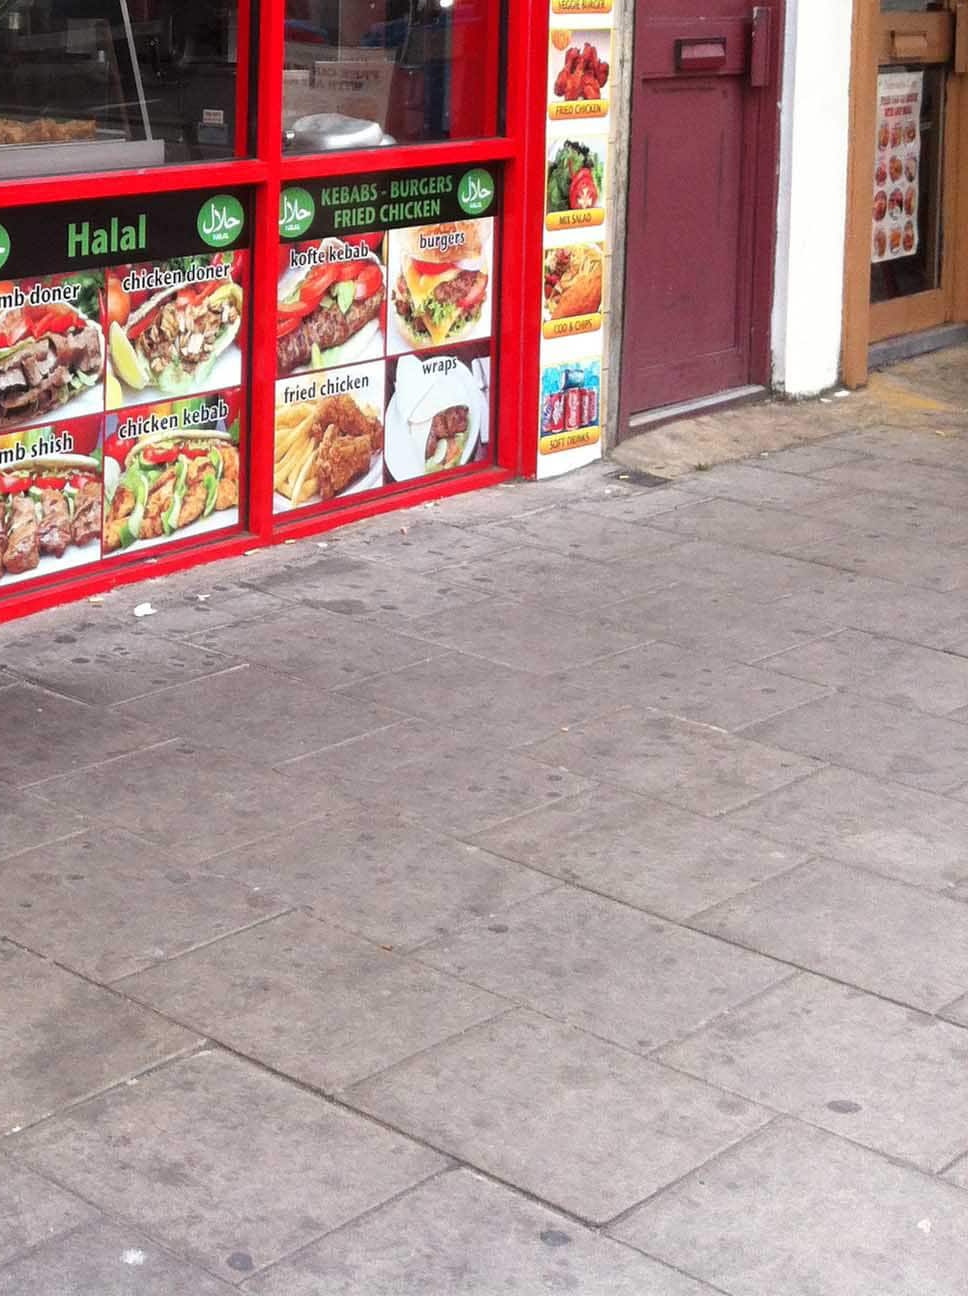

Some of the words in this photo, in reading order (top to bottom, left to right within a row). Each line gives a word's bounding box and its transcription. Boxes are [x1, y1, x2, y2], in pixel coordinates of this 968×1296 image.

[555, 105, 573, 115] FRIED
[575, 103, 601, 115] CHICKEN
[321, 183, 378, 206] KEBABS
[390, 175, 452, 198] BURGERS
[462, 175, 491, 203] حلال
[203, 202, 240, 234] حلال
[334, 207, 375, 229] FRIED
[379, 199, 440, 223] CHICKEN
[572, 212, 592, 224] SALAD
[67, 214, 146, 258] Halal
[420, 231, 465, 251] burgers
[291, 249, 325, 267] kofte
[329, 244, 369, 262] kebab
[123, 269, 181, 292] chicken
[183, 263, 230, 283] doner
[30, 283, 80, 306] doner
[554, 321, 568, 334] COD
[575, 318, 593, 331] CHIPS
[422, 358, 457, 376] wraps
[284, 381, 316, 404] fried
[320, 376, 369, 398] chicken
[119, 412, 178, 439] chicken
[183, 400, 228, 426] kebab
[31, 433, 73, 458] shish
[549, 437, 566, 451] SOFT
